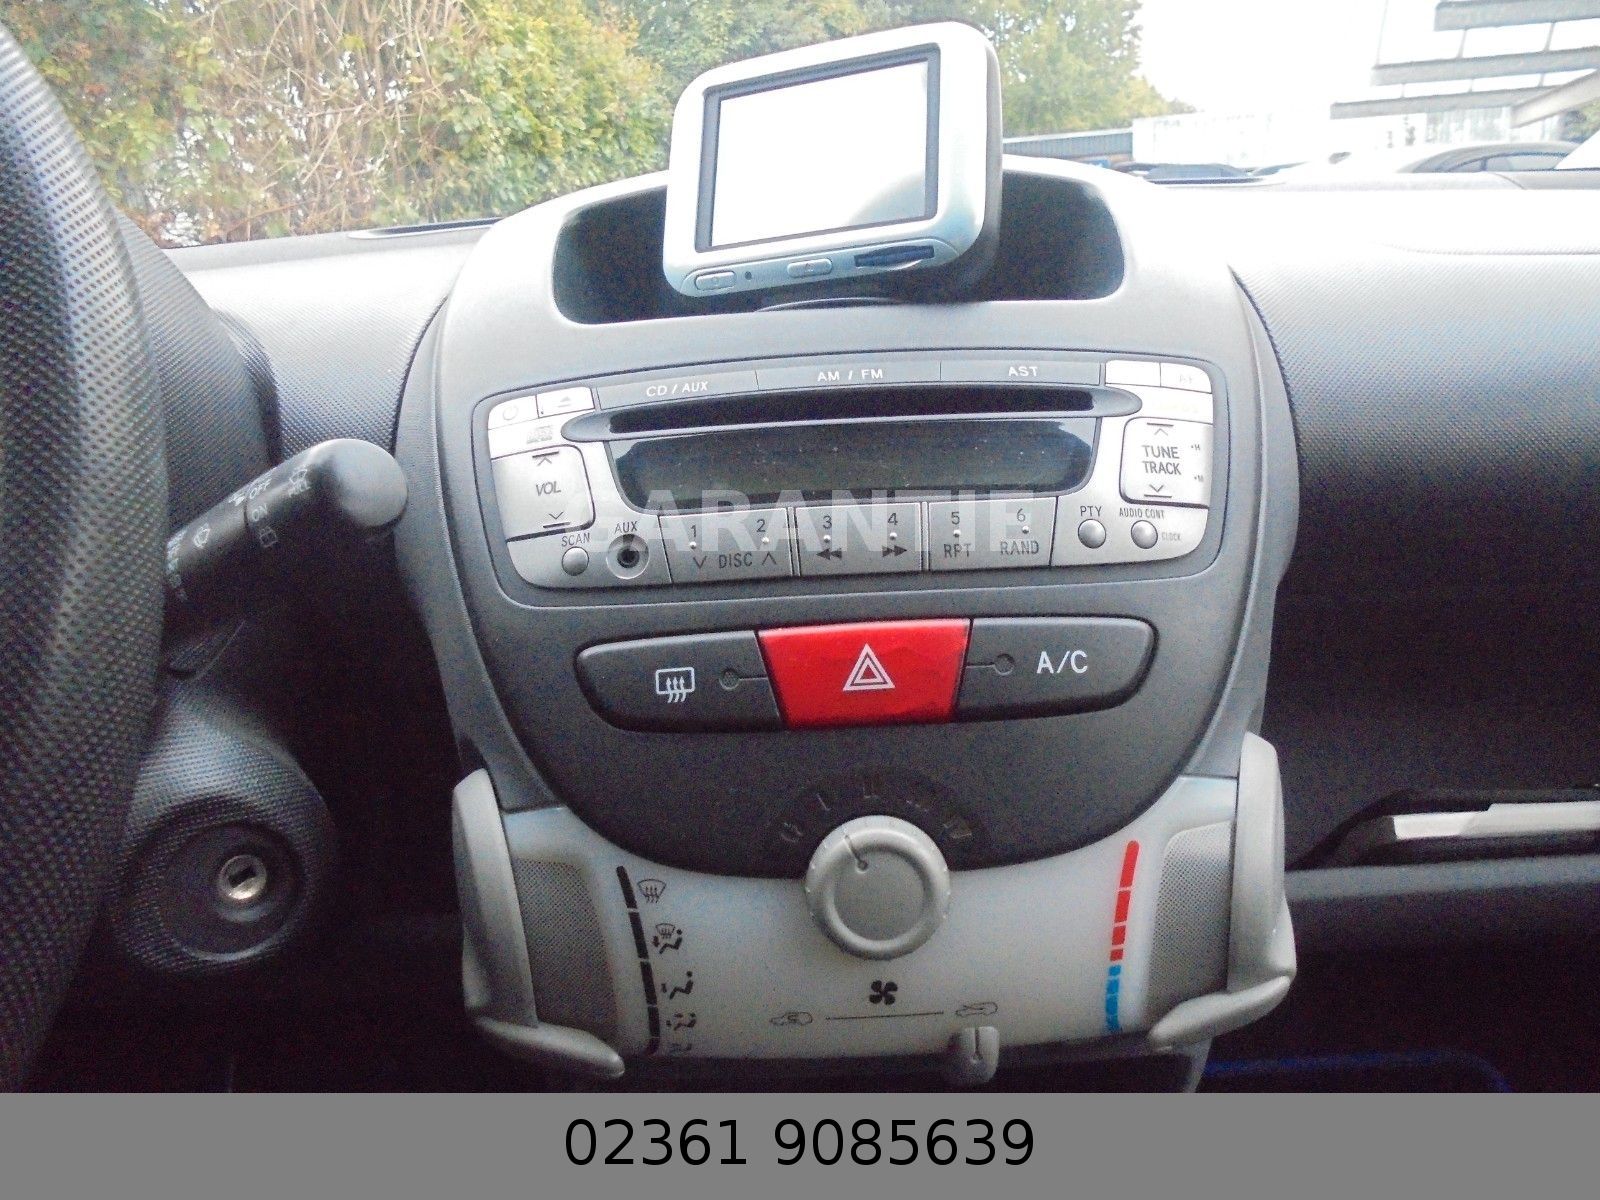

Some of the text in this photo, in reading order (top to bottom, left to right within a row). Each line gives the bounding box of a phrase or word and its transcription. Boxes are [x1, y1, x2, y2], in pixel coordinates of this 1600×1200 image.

[817, 371, 840, 381] AM
[861, 368, 883, 380] FM
[1008, 366, 1038, 377] AST
[646, 385, 668, 397] CD
[682, 381, 708, 393] AUX
[1142, 445, 1180, 459] TUNE
[1142, 460, 1182, 475] TRACK
[535, 481, 562, 496] VOL
[951, 511, 961, 525] 5
[1016, 508, 1027, 522] 6
[1080, 505, 1102, 517] PTY
[1119, 507, 1165, 519] AUDIO CONT
[756, 519, 767, 533] 2
[822, 515, 833, 529] 3
[887, 512, 898, 526] 4
[614, 521, 638, 534] AUX
[690, 524, 697, 538] 1
[561, 532, 590, 547] SCAN
[943, 543, 971, 559] RPT
[1000, 541, 1039, 556] RAND
[718, 553, 753, 568] DISC
[1036, 650, 1088, 674] A/C
